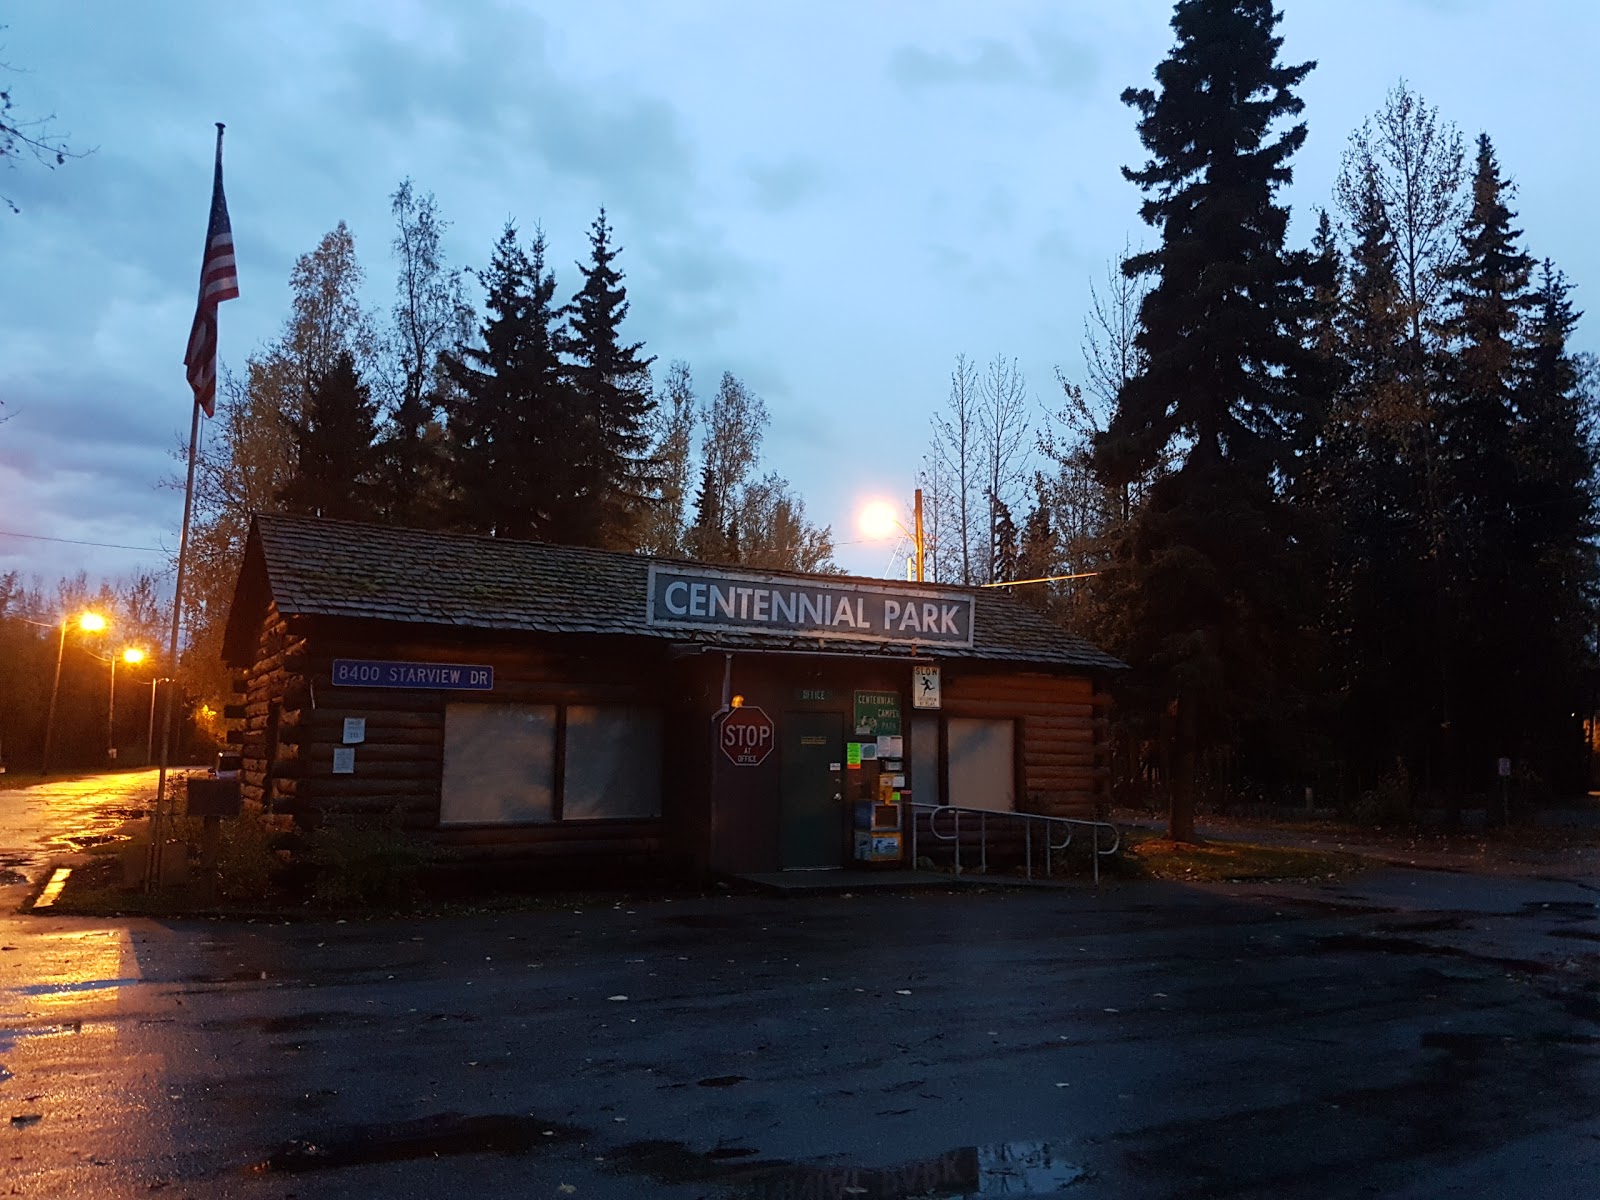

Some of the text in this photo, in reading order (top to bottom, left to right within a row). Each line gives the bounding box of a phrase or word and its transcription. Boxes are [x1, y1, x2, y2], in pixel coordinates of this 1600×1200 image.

[665, 580, 960, 636] CENTENNIAL PARK
[339, 664, 488, 686] 8400 STARVIEW DR
[915, 667, 938, 676] SLOW
[802, 689, 825, 700] OFFICE
[858, 695, 894, 705] CENTENNIAL
[725, 724, 770, 747] STOP
[737, 755, 758, 763] OFFICE
